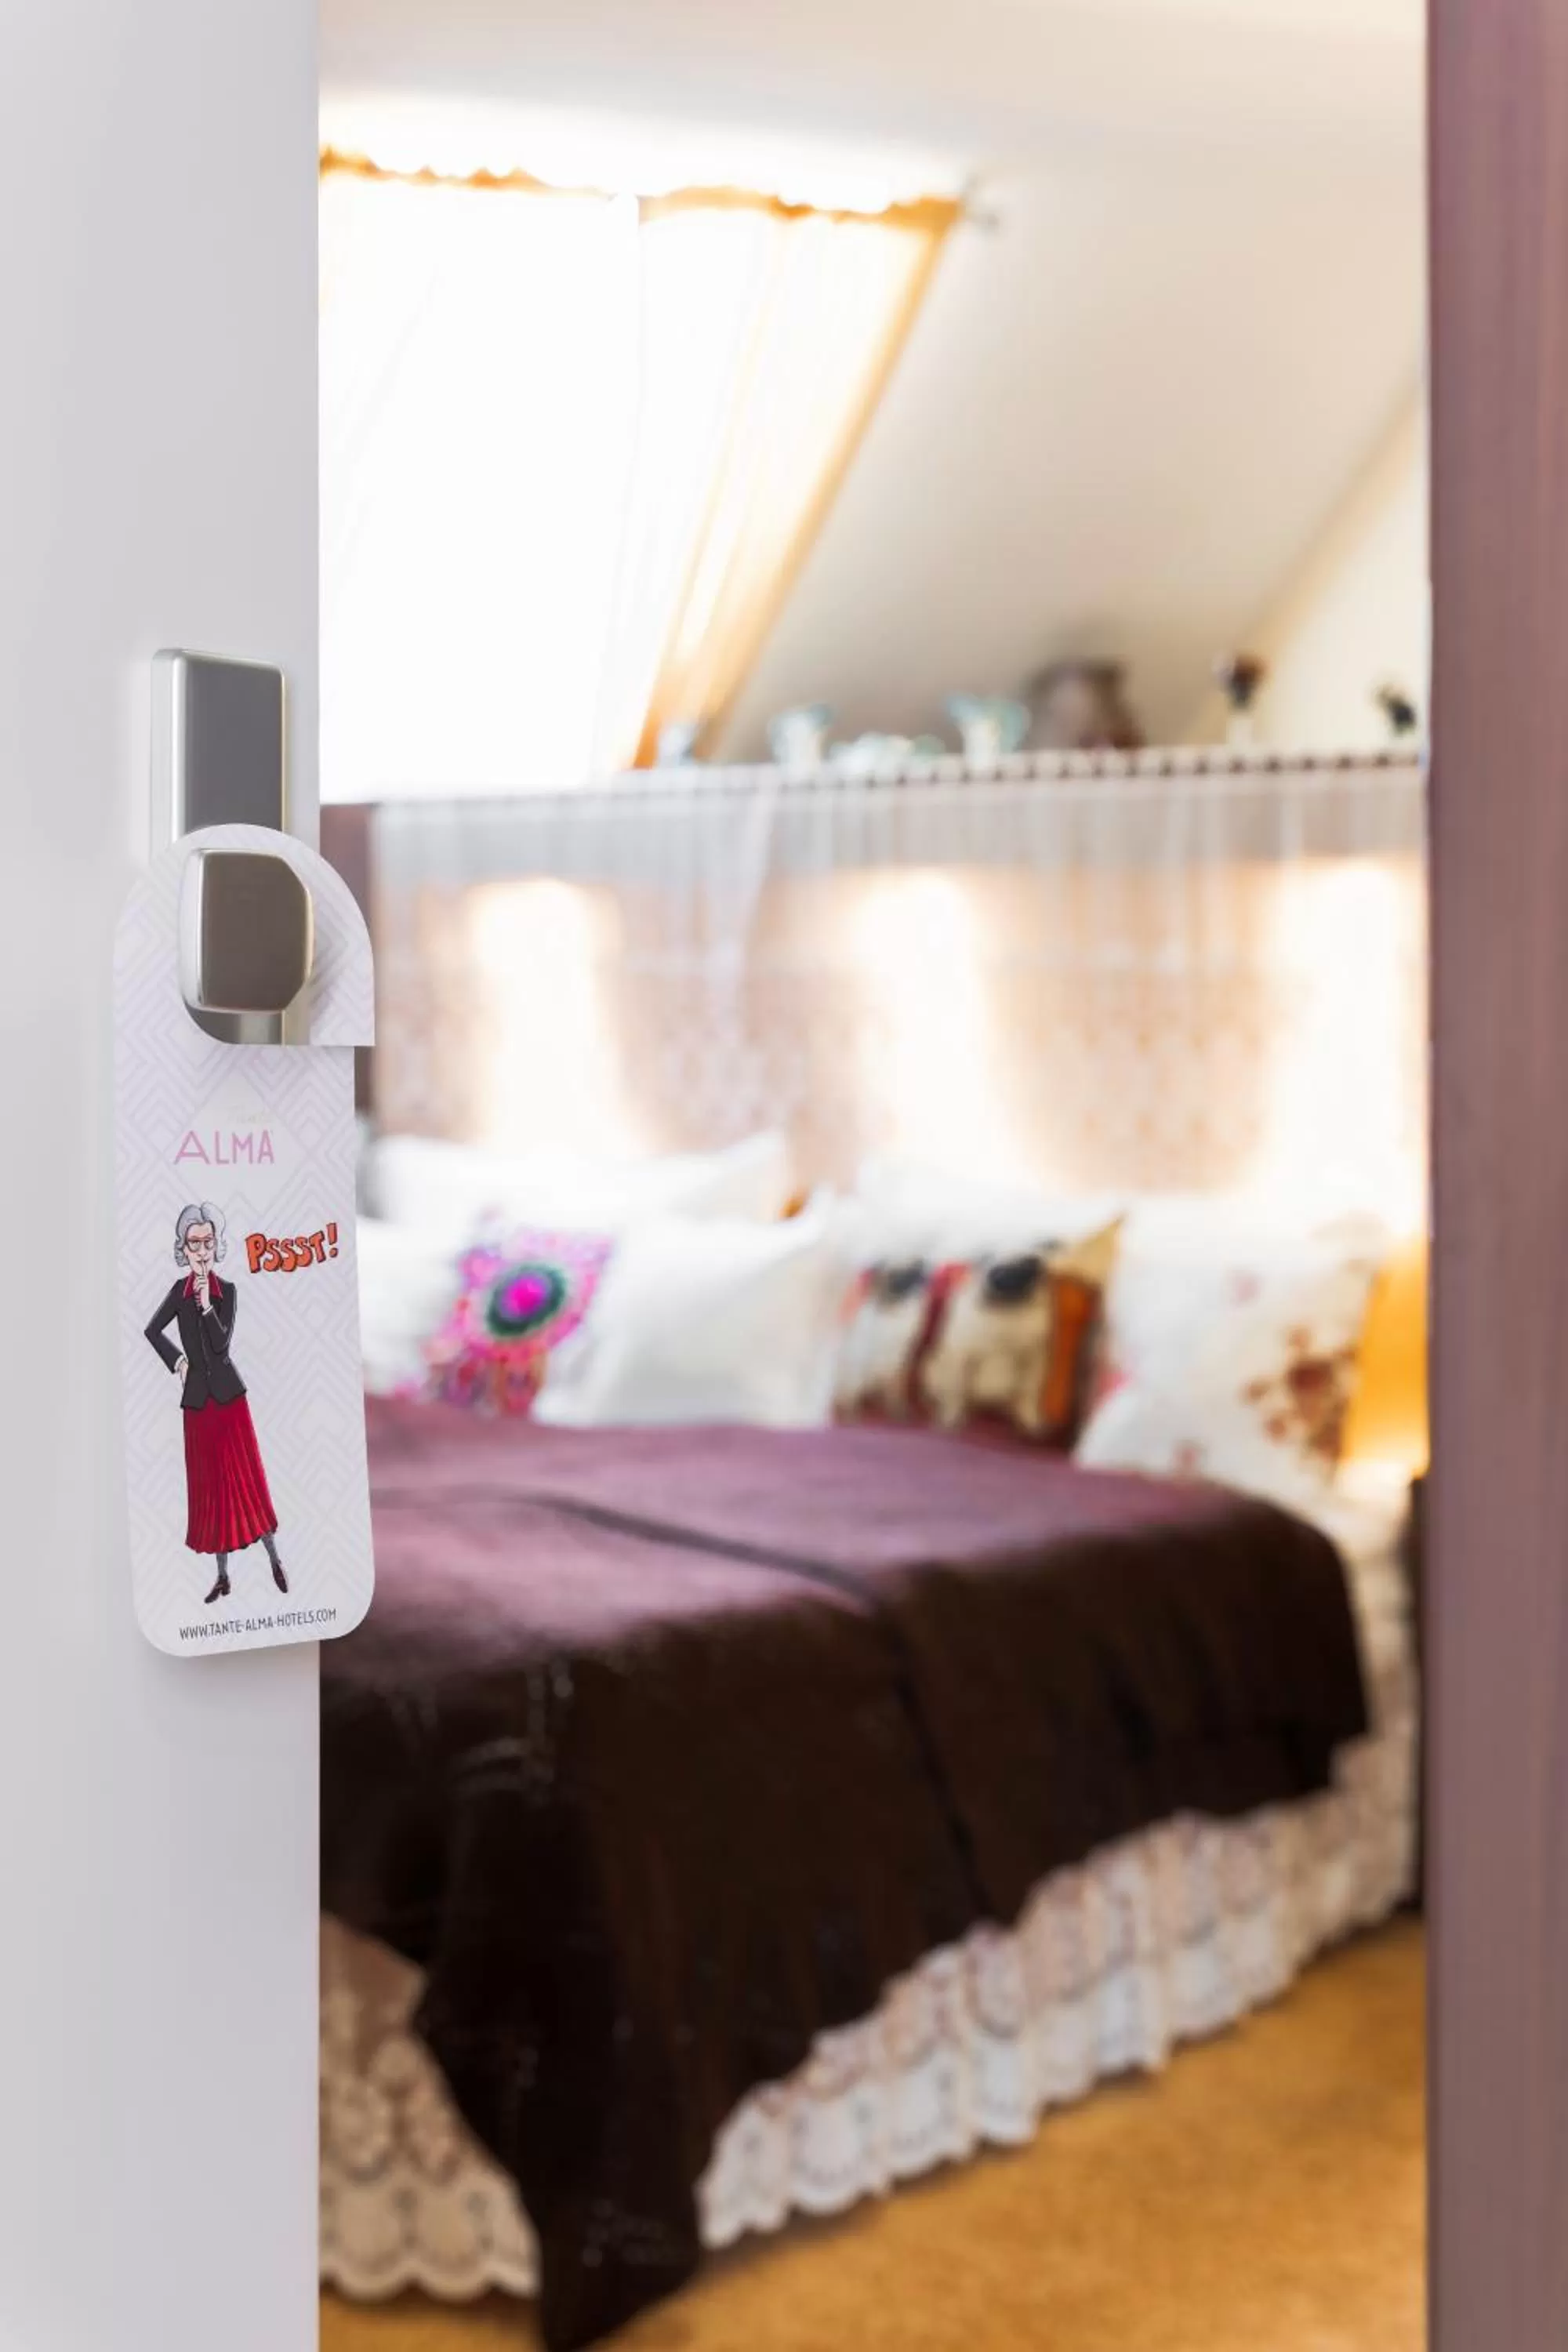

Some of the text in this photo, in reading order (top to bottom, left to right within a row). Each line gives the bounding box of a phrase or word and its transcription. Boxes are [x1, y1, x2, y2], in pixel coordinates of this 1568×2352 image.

[174, 1129, 274, 1165] ALMA
[245, 1222, 339, 1274] PSSST!
[179, 1608, 337, 1641] WWW.TANTE-ALMA-HOTELS.COM
